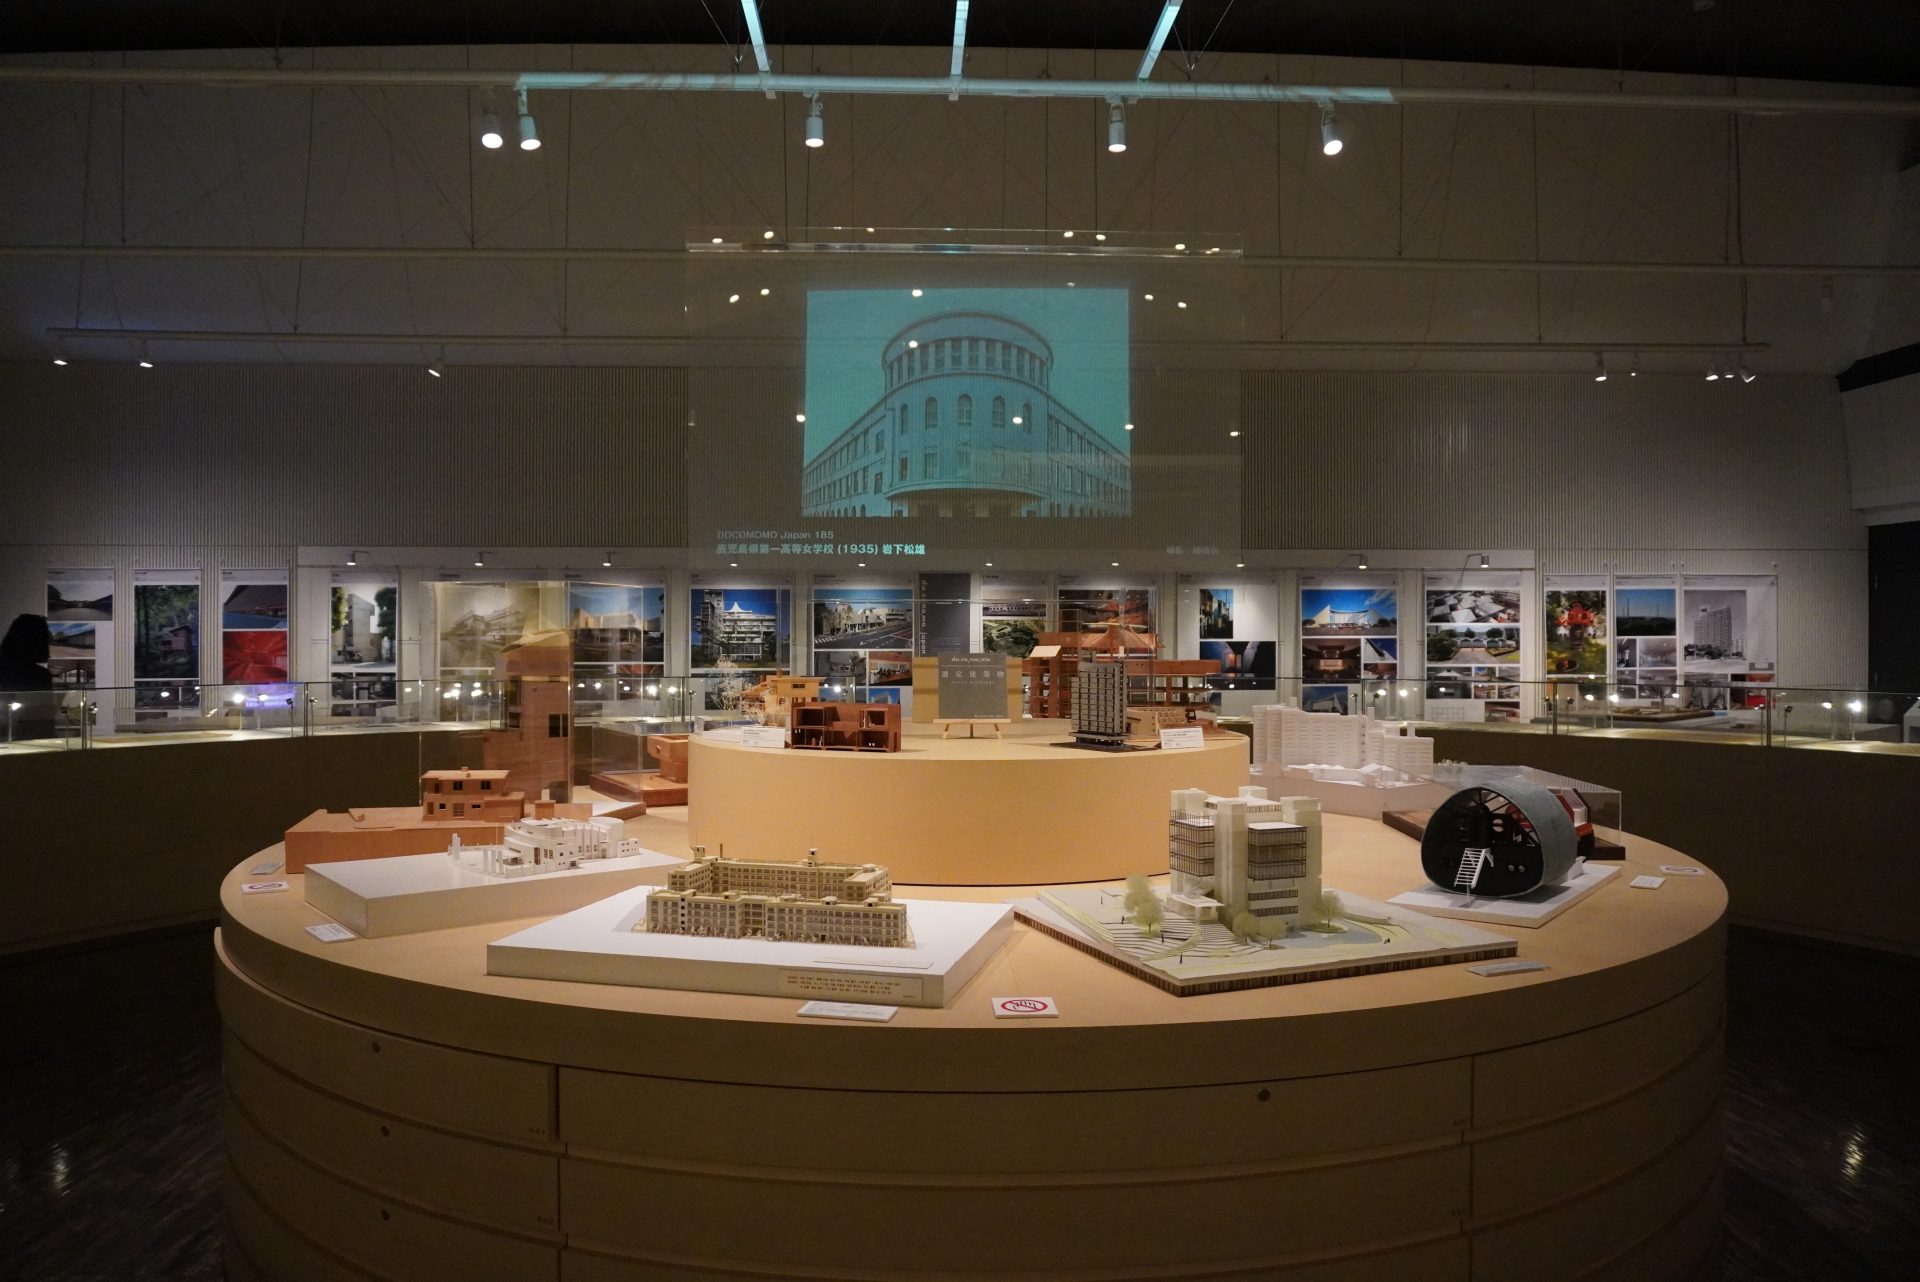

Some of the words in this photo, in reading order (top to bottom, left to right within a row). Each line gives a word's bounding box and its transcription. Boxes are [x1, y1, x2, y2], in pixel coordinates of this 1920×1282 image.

[717, 530, 778, 539] DOCOMOMO
[780, 530, 811, 541] Japan
[815, 530, 834, 539] 185
[837, 543, 879, 555] (1935)
[882, 543, 926, 555] 岩下松雄
